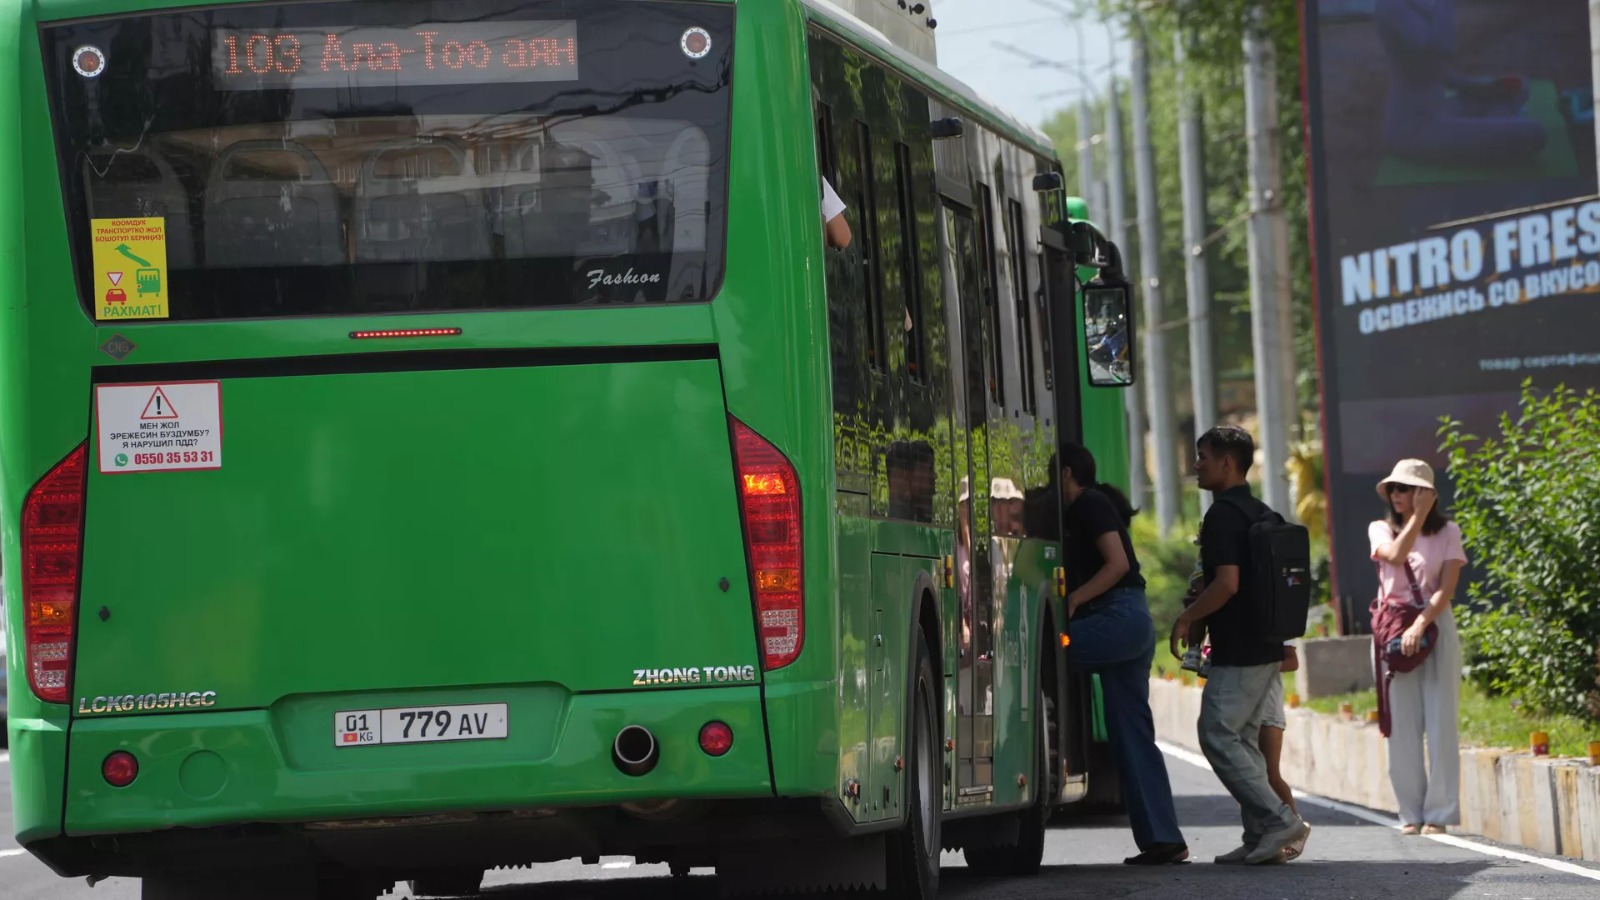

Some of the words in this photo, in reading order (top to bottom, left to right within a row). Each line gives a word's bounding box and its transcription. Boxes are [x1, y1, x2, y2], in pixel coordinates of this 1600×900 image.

[224, 35, 300, 73] 103
[320, 31, 492, 71] Ала-Тоо
[502, 37, 574, 67] аян
[1341, 228, 1483, 307] NITRO
[1494, 202, 1600, 274] FRES
[586, 267, 660, 290] Fashion
[103, 304, 162, 317] РАХМАТ!
[1359, 287, 1485, 335] ОСВЕЖИСЬ
[1488, 278, 1519, 307] СО
[108, 342, 129, 353] CNG
[110, 432, 158, 440] ЭРЕЖЕСИН
[160, 429, 210, 438] БУЗДУМБУ?
[140, 422, 158, 430] МЕН
[130, 440, 173, 448] НАРУШИЛ
[175, 438, 198, 447] ПДД?
[134, 453, 164, 465] 0550
[166, 452, 182, 463] 35
[183, 451, 199, 463] 53
[200, 450, 213, 462] 31
[633, 667, 700, 685] ZHONG
[703, 665, 755, 682] TONG
[78, 691, 217, 714] LCK6105HGC
[346, 714, 369, 732] 01
[400, 710, 451, 739] 779
[458, 713, 488, 736] AV
[359, 732, 373, 742] KG
